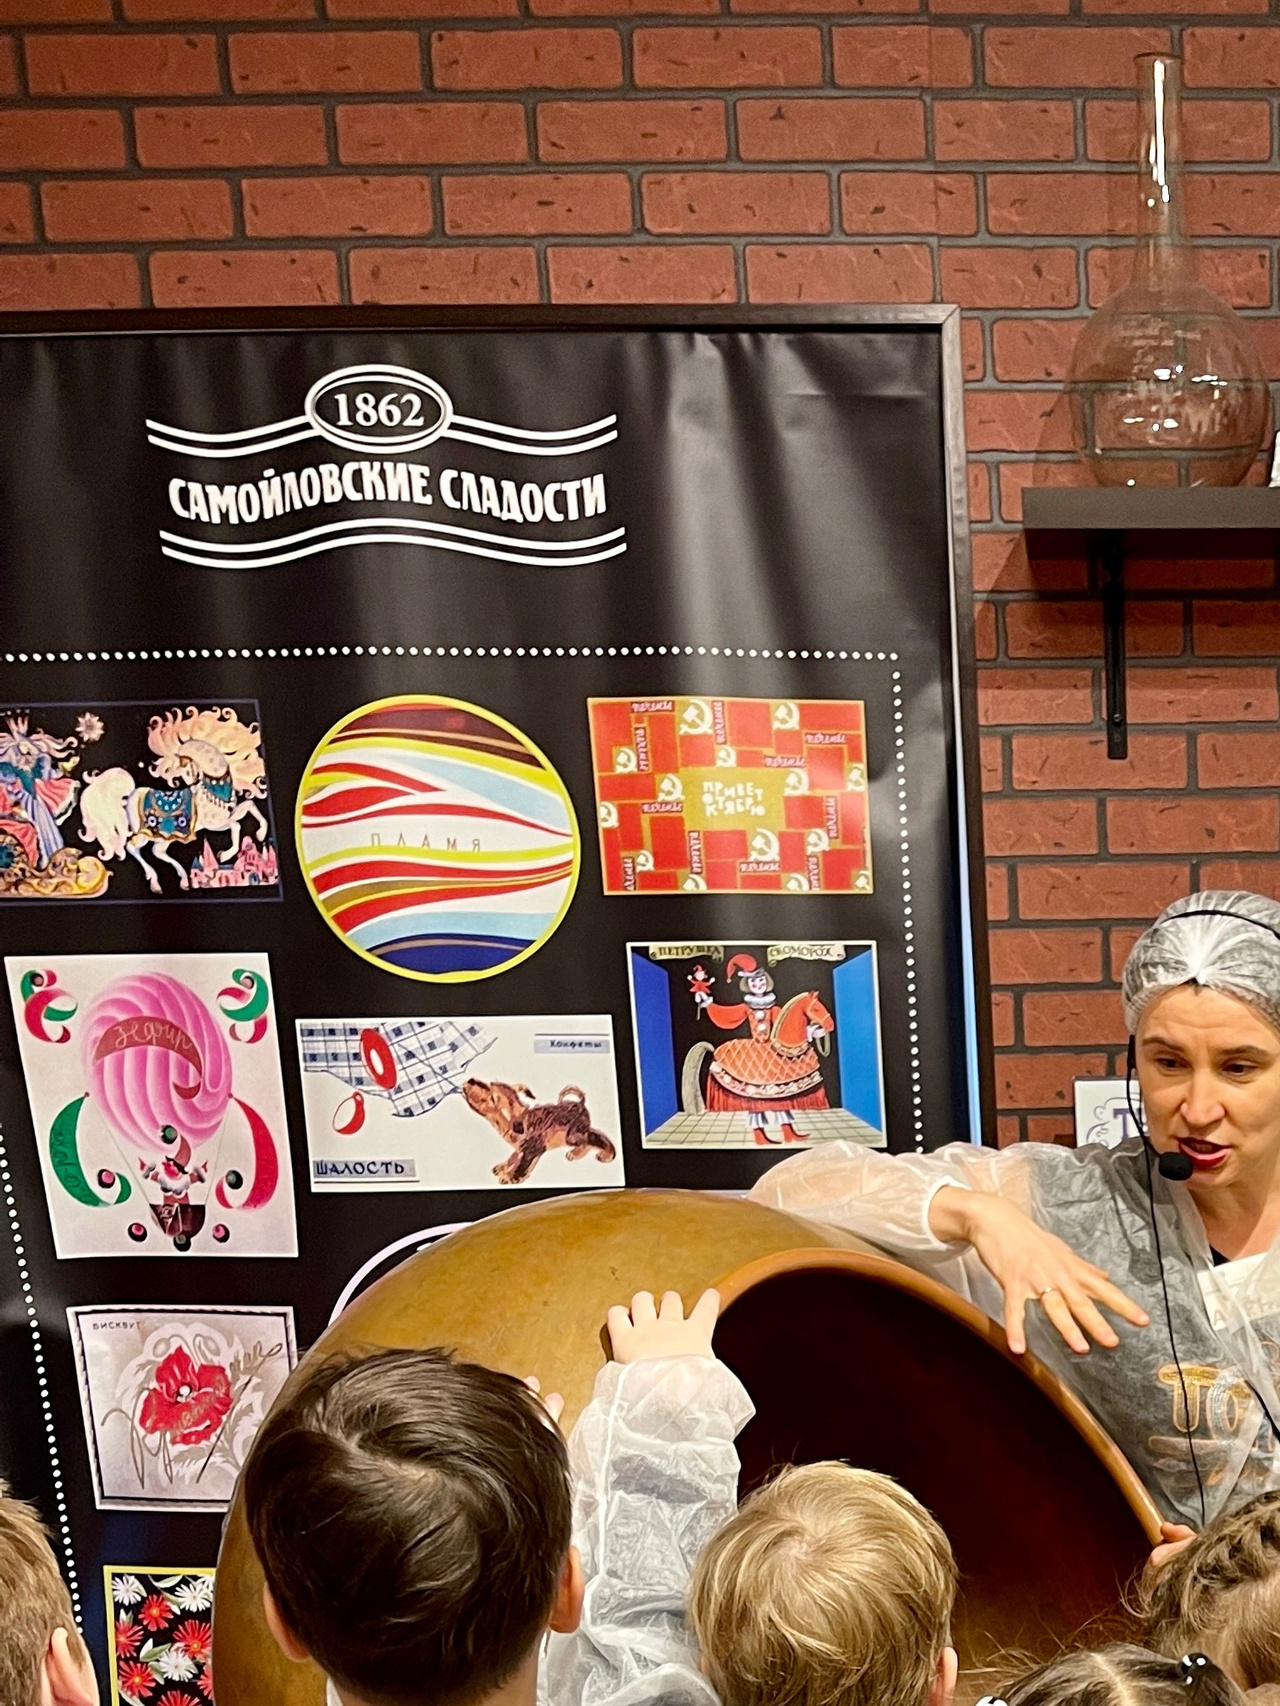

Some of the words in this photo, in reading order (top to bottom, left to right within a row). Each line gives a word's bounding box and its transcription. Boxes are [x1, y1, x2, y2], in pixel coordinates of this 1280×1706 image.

[334, 392, 425, 428] 1862
[168, 461, 433, 524] САМОЙЛОВСКИЕ
[439, 469, 607, 523] СЛАДОСТИ
[703, 781, 764, 801] ПРИВЕТ
[371, 832, 480, 853] ПЛАМЯ
[113, 1019, 193, 1049] зефир
[316, 1160, 405, 1176] ШАЛОСТЬ
